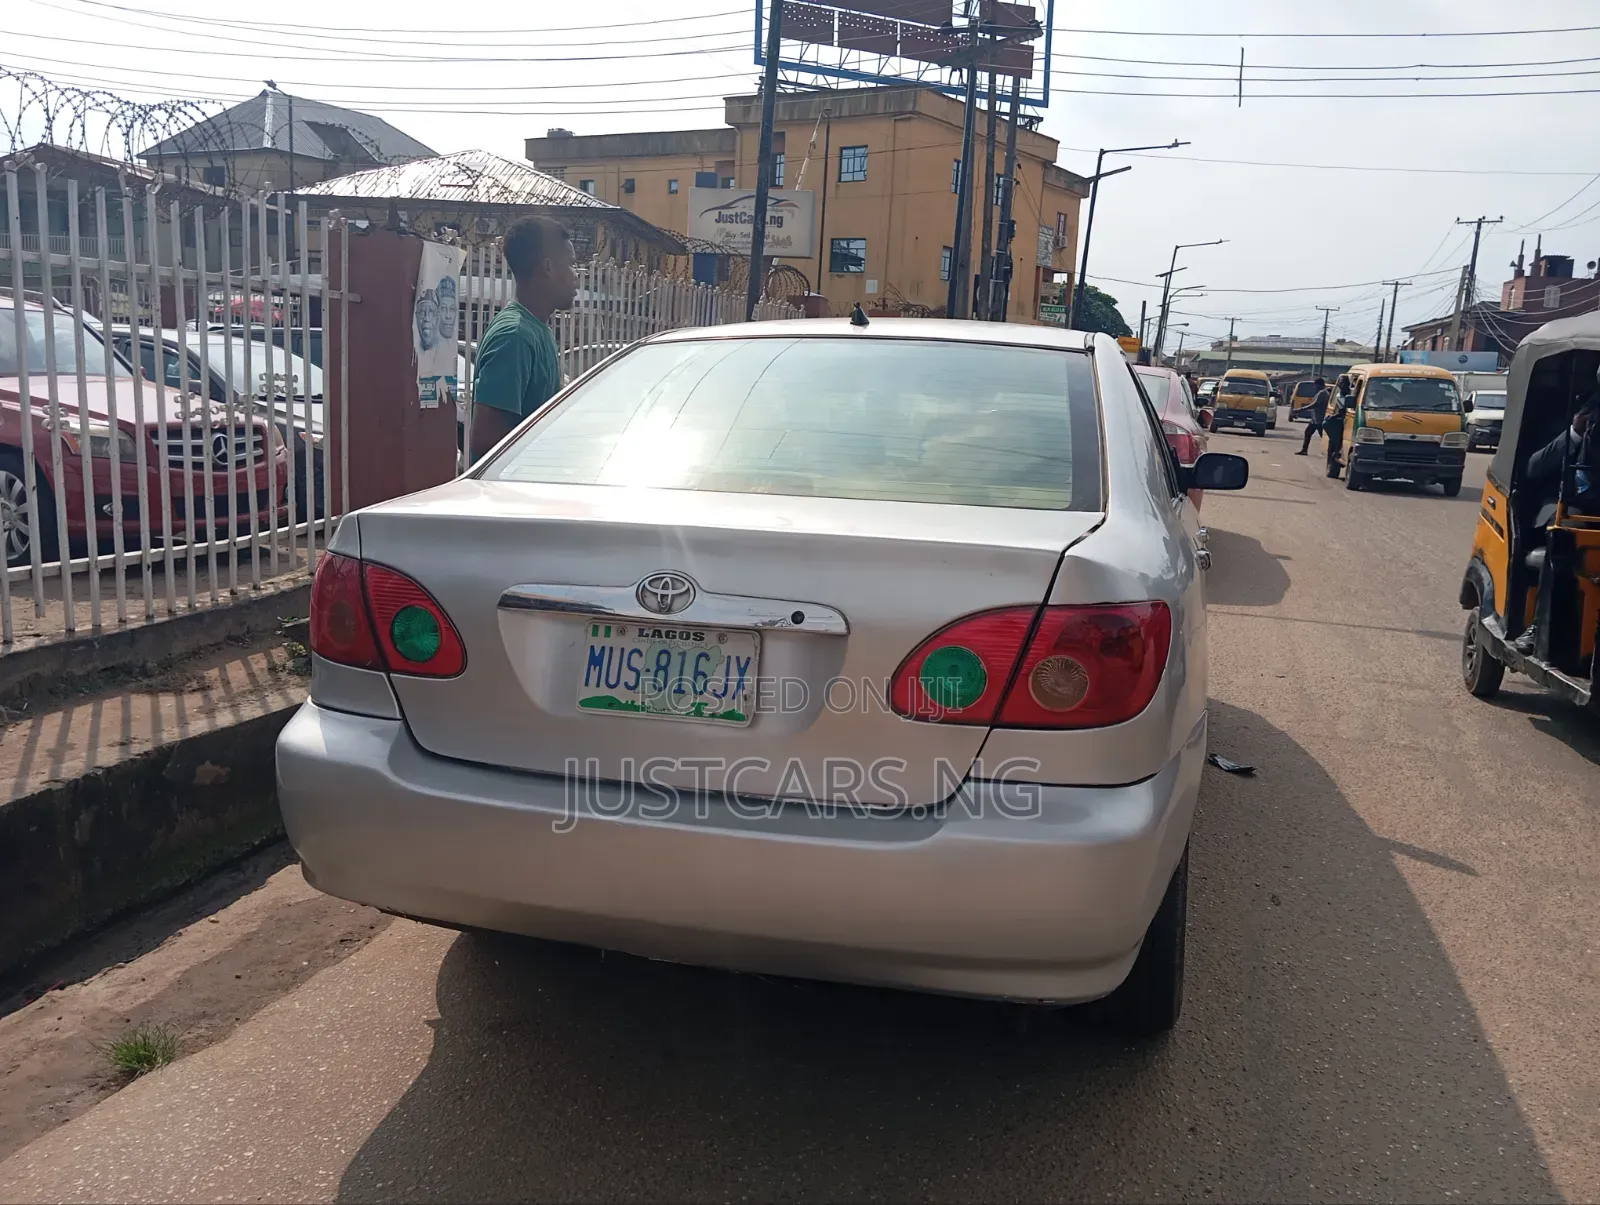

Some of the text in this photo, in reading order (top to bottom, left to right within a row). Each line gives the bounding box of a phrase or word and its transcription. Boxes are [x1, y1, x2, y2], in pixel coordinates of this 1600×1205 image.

[715, 211, 784, 228] JustCa.ng
[632, 637, 657, 645] CENTRE
[637, 627, 706, 642] LAGOS
